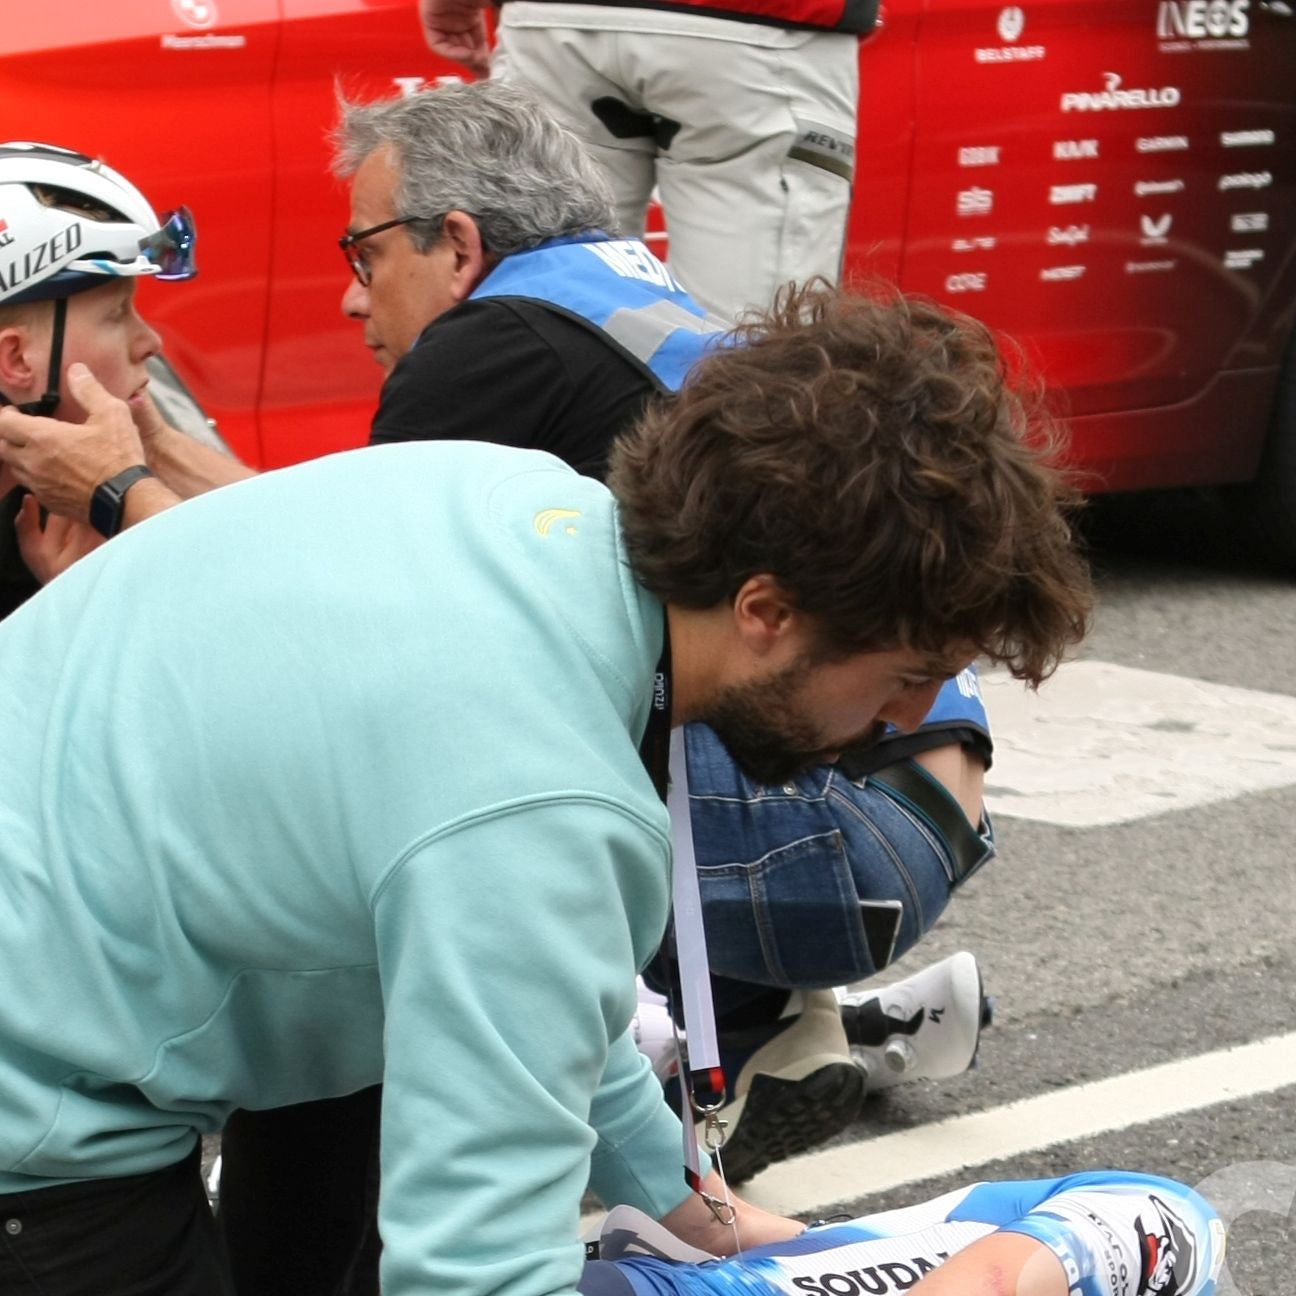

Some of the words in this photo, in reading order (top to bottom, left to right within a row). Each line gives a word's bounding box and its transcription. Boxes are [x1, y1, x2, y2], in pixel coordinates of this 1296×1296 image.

[1157, 0, 1250, 38] INEOS
[975, 46, 1046, 62] BELSTAFF
[1061, 87, 1181, 111] PINARELLO
